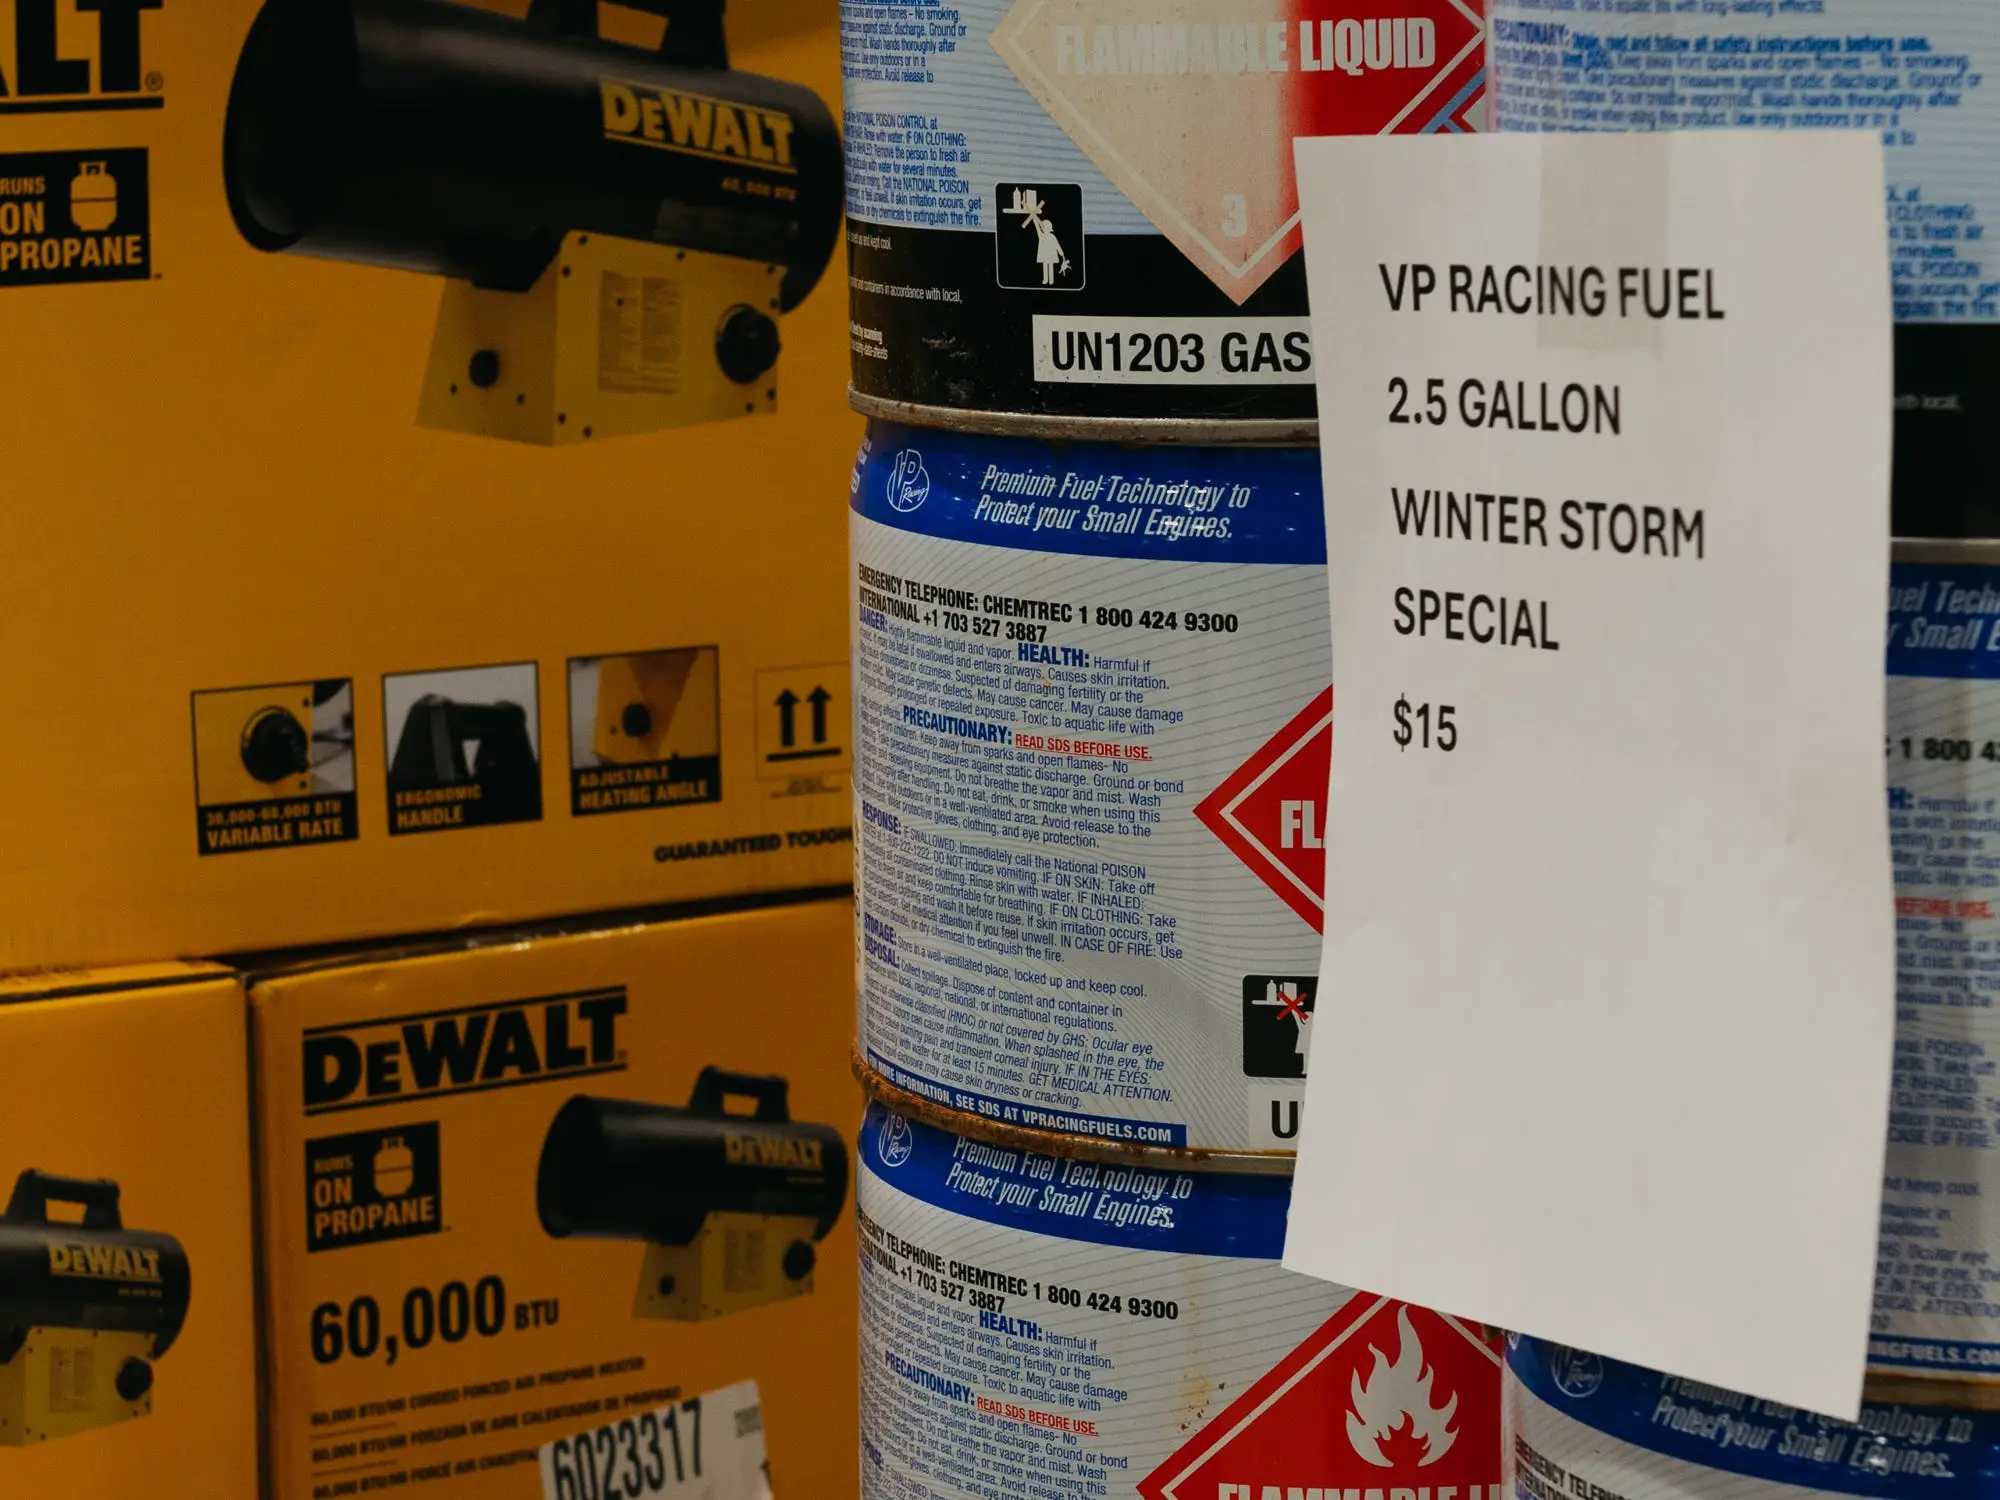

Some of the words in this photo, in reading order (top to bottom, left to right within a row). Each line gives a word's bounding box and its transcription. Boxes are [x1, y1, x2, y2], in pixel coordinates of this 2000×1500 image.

[894, 22, 927, 38] discharge.
[929, 22, 956, 37] Ground
[926, 8, 961, 24] smoking.
[938, 41, 956, 52] after
[1056, 21, 1289, 74] FLAMMABLE
[1299, 17, 1436, 76] LIQUID
[925, 132, 967, 147] CLOTHING:
[939, 150, 958, 162] fresh
[959, 151, 971, 162] air
[903, 178, 938, 192] NATIONAL
[939, 179, 969, 194] POISON
[927, 165, 958, 178] minutes.
[0, 202, 45, 235] ON
[938, 197, 966, 211] occurs,
[968, 197, 982, 212] get
[965, 212, 981, 226] fire.
[1220, 193, 1248, 238] 3
[0, 235, 143, 271] PROPANE
[925, 287, 941, 301] with
[1378, 264, 1436, 311] VP
[1449, 264, 1607, 317] RACING
[1618, 267, 1725, 320] FUEL
[1051, 330, 1205, 373] UN1203
[1220, 331, 1312, 373] GAS
[1388, 377, 1447, 426] 2.5
[1459, 378, 1621, 436] GALLON
[980, 464, 1058, 498] Premium
[1058, 472, 1104, 501] Fuel
[1106, 476, 1224, 512] Technology
[1228, 484, 1251, 508] to
[974, 494, 1035, 526] Protect
[1033, 508, 1080, 531] your
[1082, 505, 1142, 534] Small
[1144, 508, 1233, 541] Engines.
[1391, 487, 1548, 547] WINTER
[1559, 500, 1704, 560] STORM
[905, 580, 979, 611] TELEPHONE:
[983, 594, 1073, 624] CHEMTREC
[1079, 605, 1088, 624] 1
[1096, 607, 1133, 627] 800
[1139, 610, 1178, 630] 424
[1184, 613, 1238, 633] 9300
[1889, 581, 1930, 612] uel
[923, 608, 938, 627] +1
[943, 612, 969, 633] 703
[972, 617, 1001, 637] 527
[1005, 622, 1048, 643] 3887
[1393, 586, 1560, 651] SPECIAL
[1018, 643, 1089, 668] HEALTH:
[1094, 656, 1139, 672] Harmful
[1048, 667, 1088, 684] Causes
[1091, 671, 1114, 686] skin
[1118, 674, 1170, 690] irritation.
[903, 705, 1013, 745] PRECAUTIONARY:
[1015, 733, 1044, 749] READ
[1047, 738, 1070, 752] SDS
[1074, 741, 1121, 757] BEFORE
[1124, 746, 1153, 759] USE.
[1135, 707, 1184, 724] damage
[1392, 692, 1458, 752] $15
[1923, 737, 1972, 761] 800
[579, 785, 651, 809] HEATING
[656, 779, 708, 801] ANGLE
[1093, 774, 1134, 790] Ground
[1138, 780, 1151, 791] or
[1154, 779, 1184, 793] bond
[206, 823, 292, 849] VARIABLE
[299, 817, 343, 840] RATE
[397, 805, 463, 828] HANDLE
[654, 833, 782, 862] GUARANTEED
[1120, 983, 1148, 997] cool.
[1028, 1073, 1048, 1087] GET
[1051, 1075, 1101, 1094] MEDICAL
[1103, 1084, 1174, 1103] ATTENTION.
[955, 1093, 975, 1112] SEE
[978, 1100, 1000, 1118] SDS
[1003, 1106, 1018, 1121] AT
[1022, 1110, 1172, 1143] VPRACINGFUELS.COM
[953, 1136, 1016, 1174] Premium
[1020, 1152, 1055, 1181] Fuel
[1171, 1174, 1193, 1200] to
[314, 1176, 352, 1208] ON
[945, 1163, 999, 1198] Protect
[996, 1178, 1038, 1206] your
[1039, 1185, 1091, 1218] Small
[1093, 1191, 1175, 1228] Engines.
[315, 1195, 435, 1239] PROPANE
[886, 1231, 946, 1275] TELEPHONE:
[950, 1260, 1027, 1297] CHEMTREC
[1033, 1282, 1041, 1300] 1
[1047, 1286, 1081, 1308] 800
[1086, 1292, 1122, 1314] 424
[1128, 1297, 1179, 1321] 9300
[900, 1264, 912, 1283] +1
[916, 1269, 937, 1293] 703
[940, 1276, 965, 1302] 527
[968, 1289, 1005, 1314] 3887
[310, 1275, 506, 1366] 60,000
[513, 1297, 560, 1331] BTU
[979, 1310, 1042, 1341] HEALTH:
[885, 1350, 975, 1406] PRECAUTIONARY:
[977, 1396, 1002, 1414] READ
[1005, 1404, 1026, 1420] SDS
[1028, 1409, 1069, 1430] BEFORE
[1072, 1420, 1099, 1436] USE.
[551, 1397, 702, 1500] 6023317
[1778, 1425, 1844, 1463] Small
